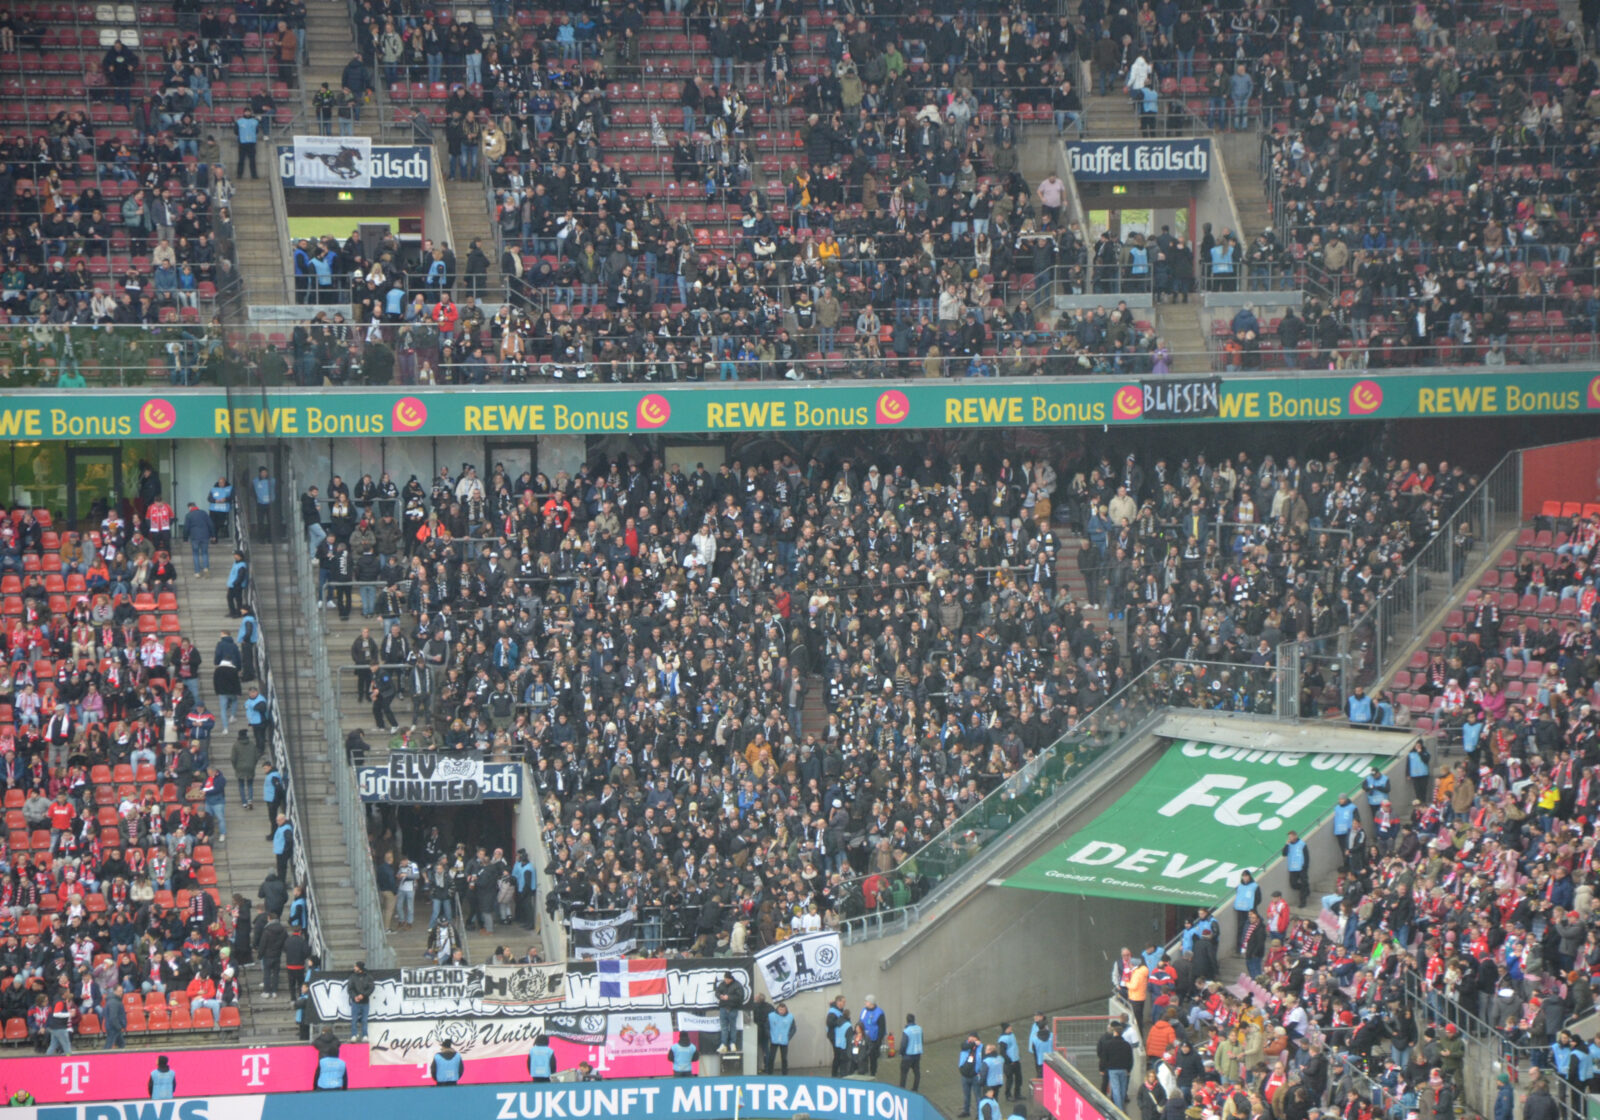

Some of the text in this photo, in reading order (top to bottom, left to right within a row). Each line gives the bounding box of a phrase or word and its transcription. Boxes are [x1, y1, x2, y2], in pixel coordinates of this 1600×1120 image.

[370, 152, 429, 182] ölsch
[1135, 144, 1208, 174] Kölsch
[945, 396, 1105, 424] REWE Bonus
[1219, 391, 1341, 418] WE Bonus
[1418, 385, 1580, 414] REWE Bonus
[0, 408, 132, 435] WE Bonus
[214, 407, 384, 434] REWE Bonus
[464, 404, 629, 431] REWE Bonus
[706, 401, 868, 428] REWE Bonus
[390, 753, 437, 780] ELV
[389, 779, 480, 801] UNITED
[1157, 774, 1329, 831] FC!
[1066, 841, 1260, 888] DEVK
[403, 985, 465, 999] KOLLEKTIV
[372, 1028, 433, 1057] Loyal
[479, 1023, 543, 1046] Unity
[60, 1061, 90, 1094] T
[241, 1054, 270, 1086] T
[496, 1083, 908, 1120] ZUKUNFT MIT TRADITION
